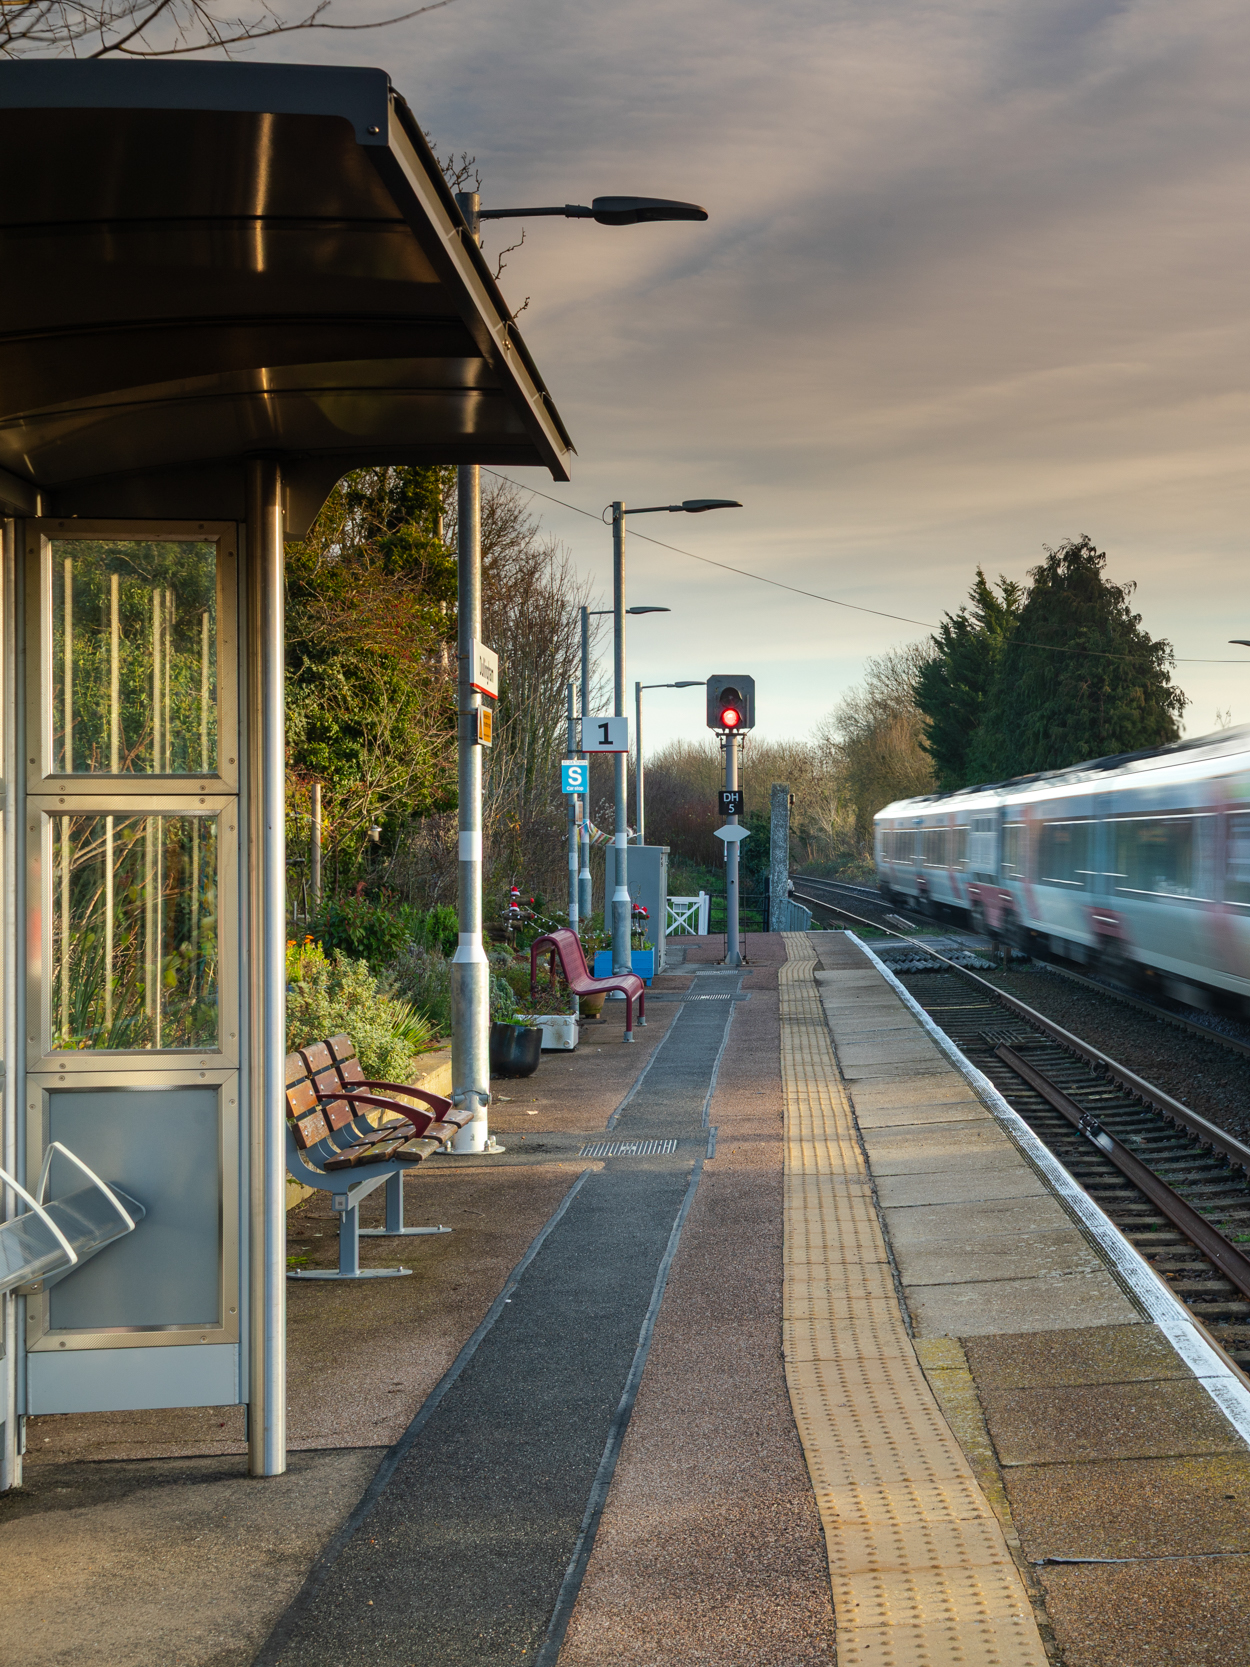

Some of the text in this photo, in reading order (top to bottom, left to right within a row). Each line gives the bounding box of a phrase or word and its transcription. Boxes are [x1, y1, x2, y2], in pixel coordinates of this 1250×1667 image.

[598, 722, 613, 745] 1
[568, 767, 582, 785] S
[724, 793, 738, 801] DH
[729, 804, 734, 813] 5
